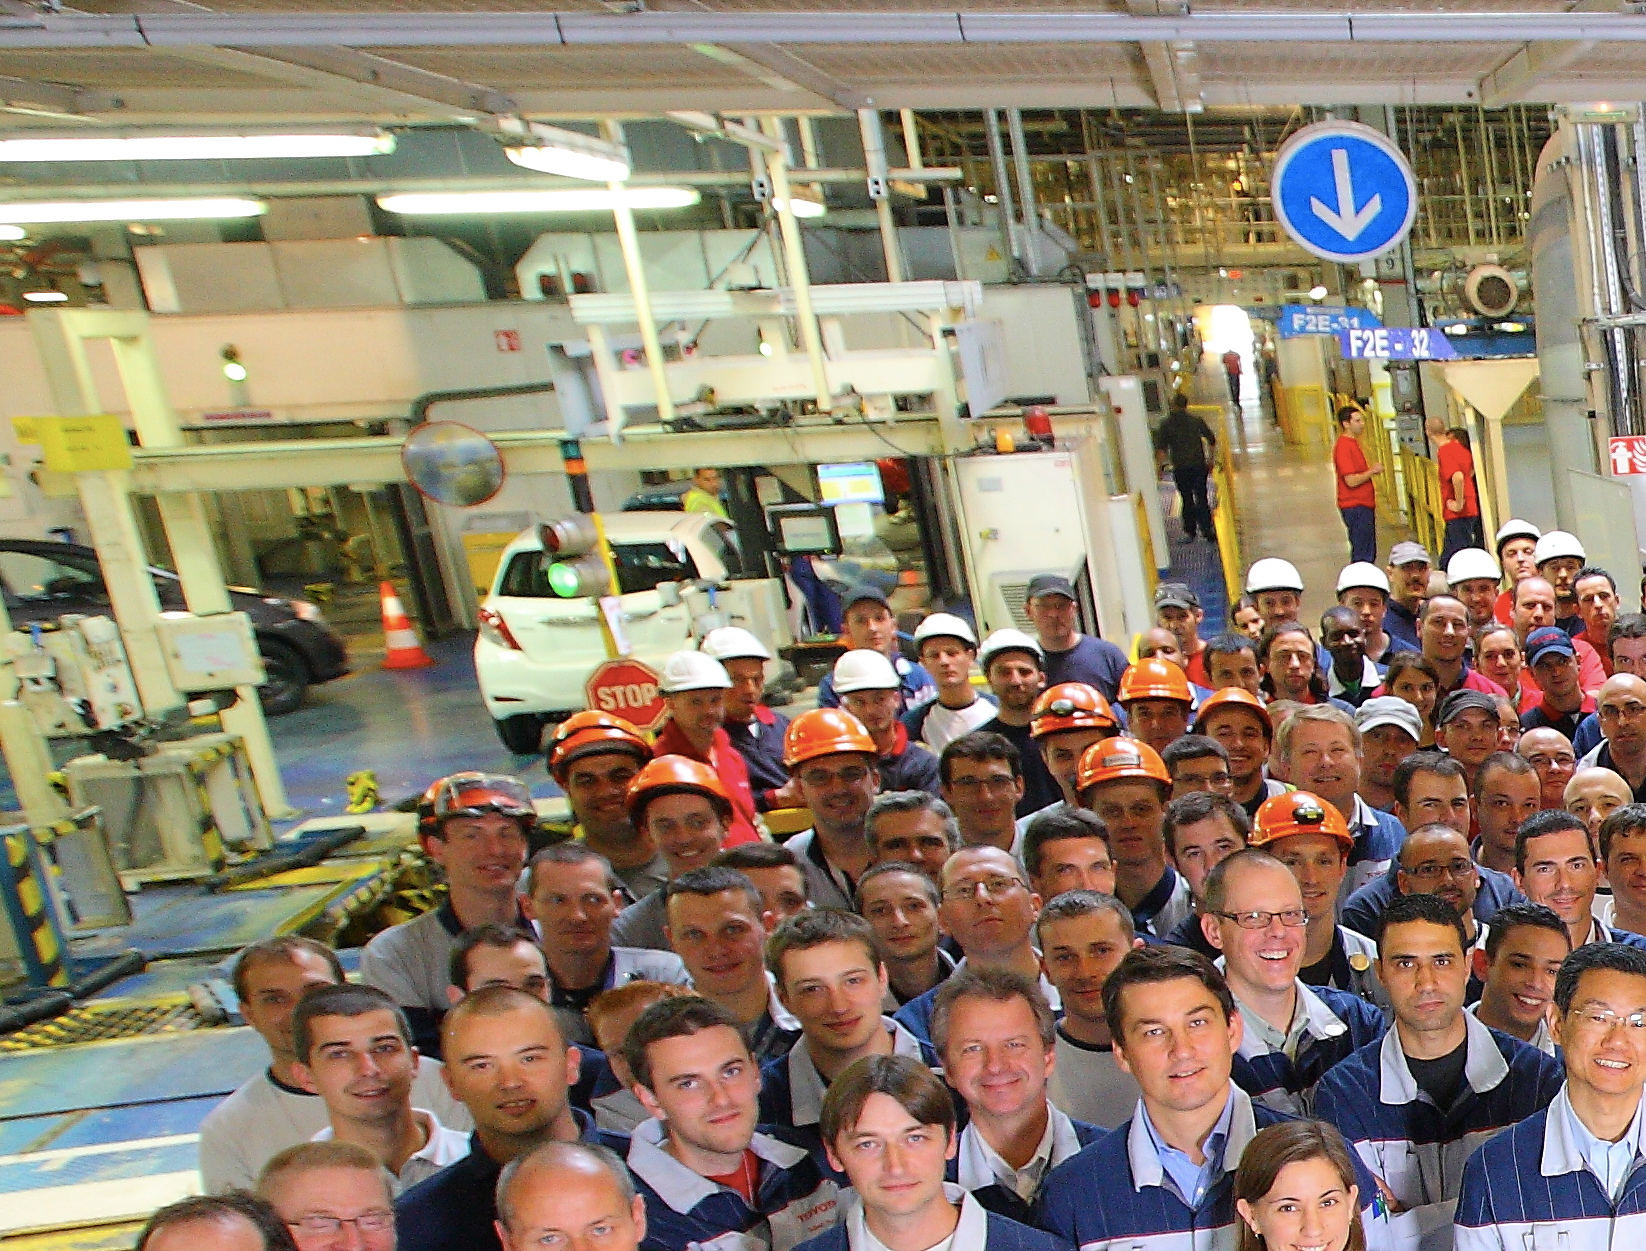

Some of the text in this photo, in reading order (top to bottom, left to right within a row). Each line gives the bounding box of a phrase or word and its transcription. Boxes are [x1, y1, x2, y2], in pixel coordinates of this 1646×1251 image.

[1350, 329, 1391, 358] F2E
[1411, 329, 1431, 358] 32
[596, 683, 657, 711] STOP
